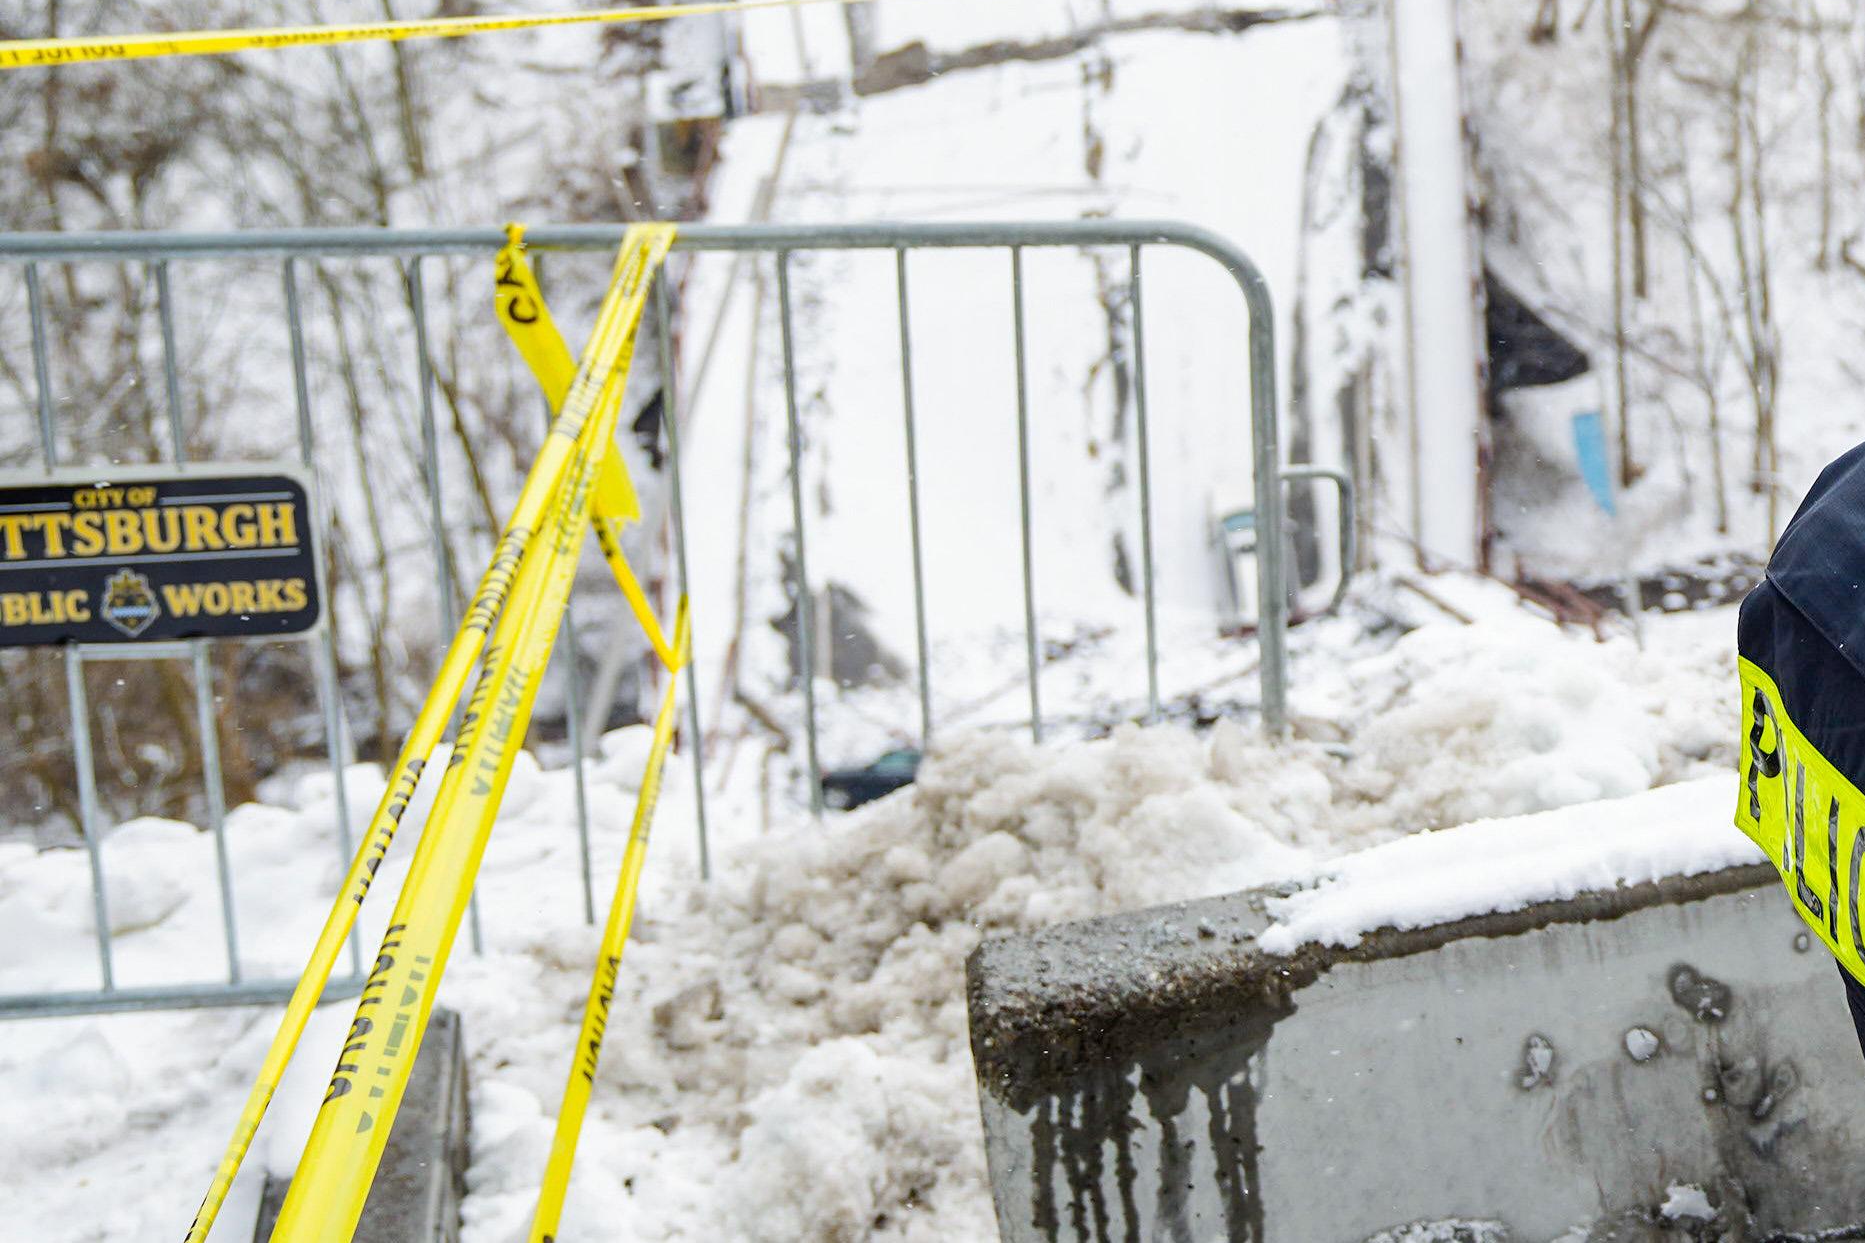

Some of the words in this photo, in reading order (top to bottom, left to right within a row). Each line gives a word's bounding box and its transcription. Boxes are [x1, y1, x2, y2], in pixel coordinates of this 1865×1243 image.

[73, 488, 125, 509] CITY
[126, 485, 158, 507] OF
[162, 577, 308, 618] WORKS
